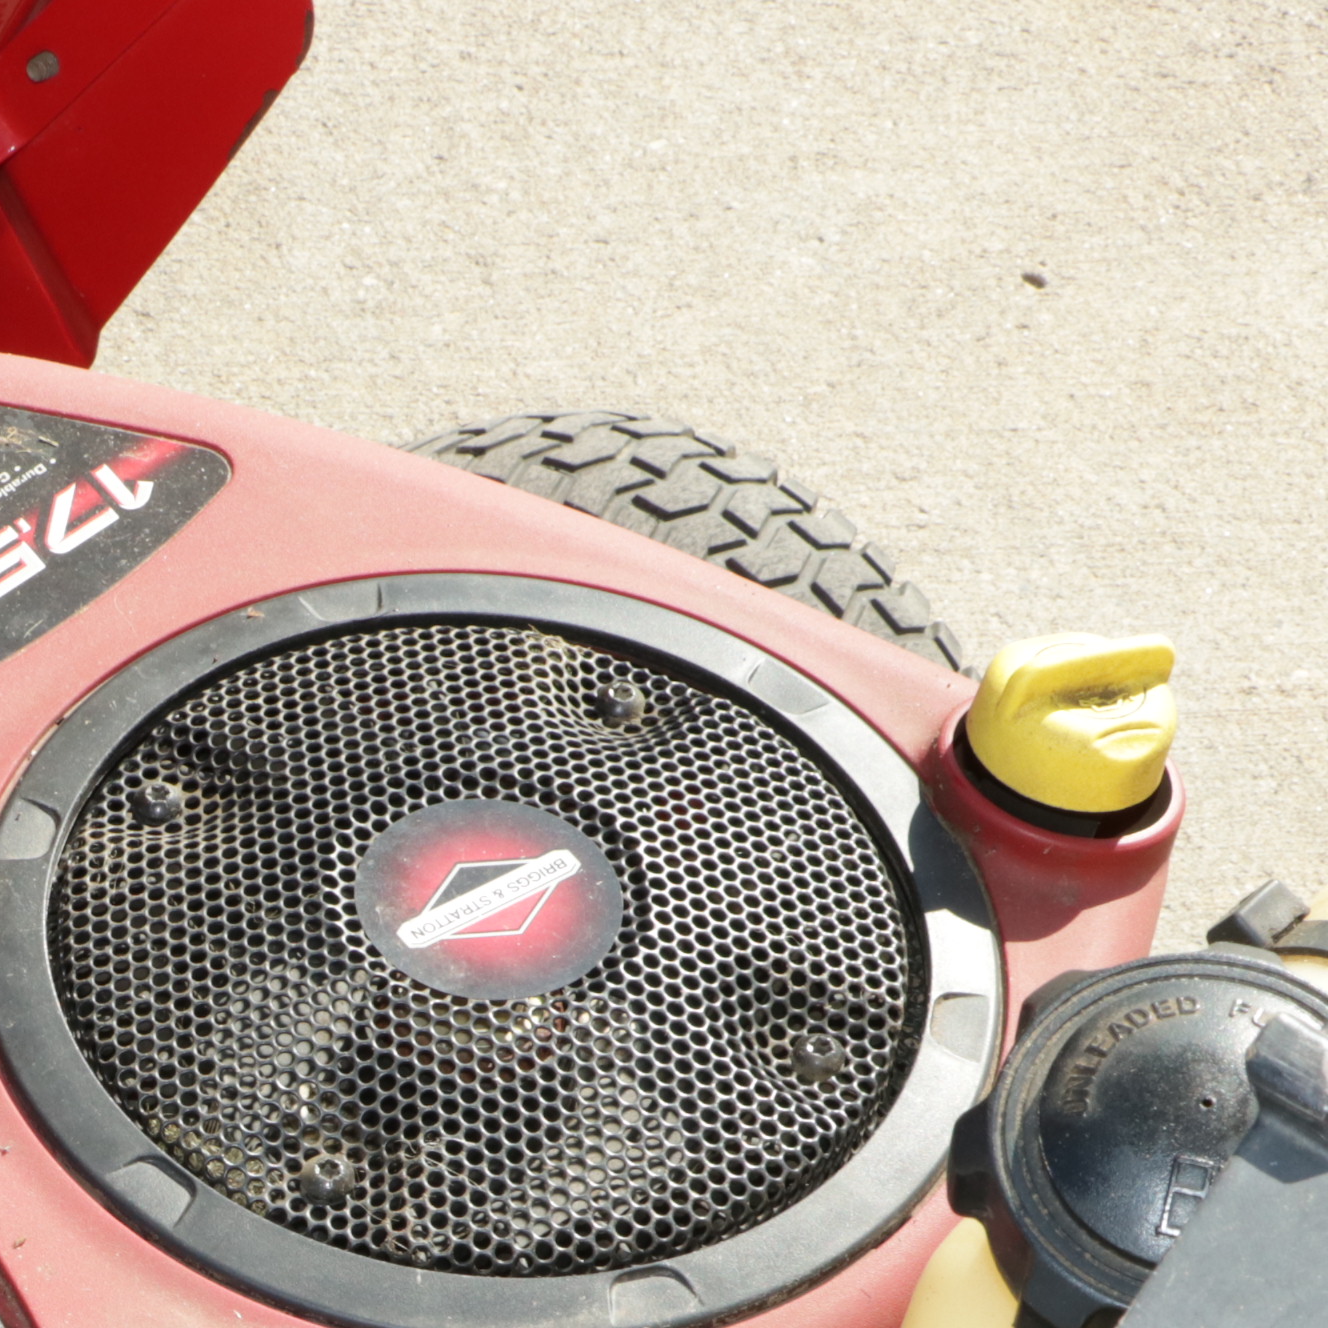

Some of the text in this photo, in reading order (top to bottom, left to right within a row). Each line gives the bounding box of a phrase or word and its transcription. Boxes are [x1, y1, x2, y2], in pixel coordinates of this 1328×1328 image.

[410, 858, 568, 939] BRIGGS & STRATTON
[1059, 995, 1202, 1117] UNLEADED
